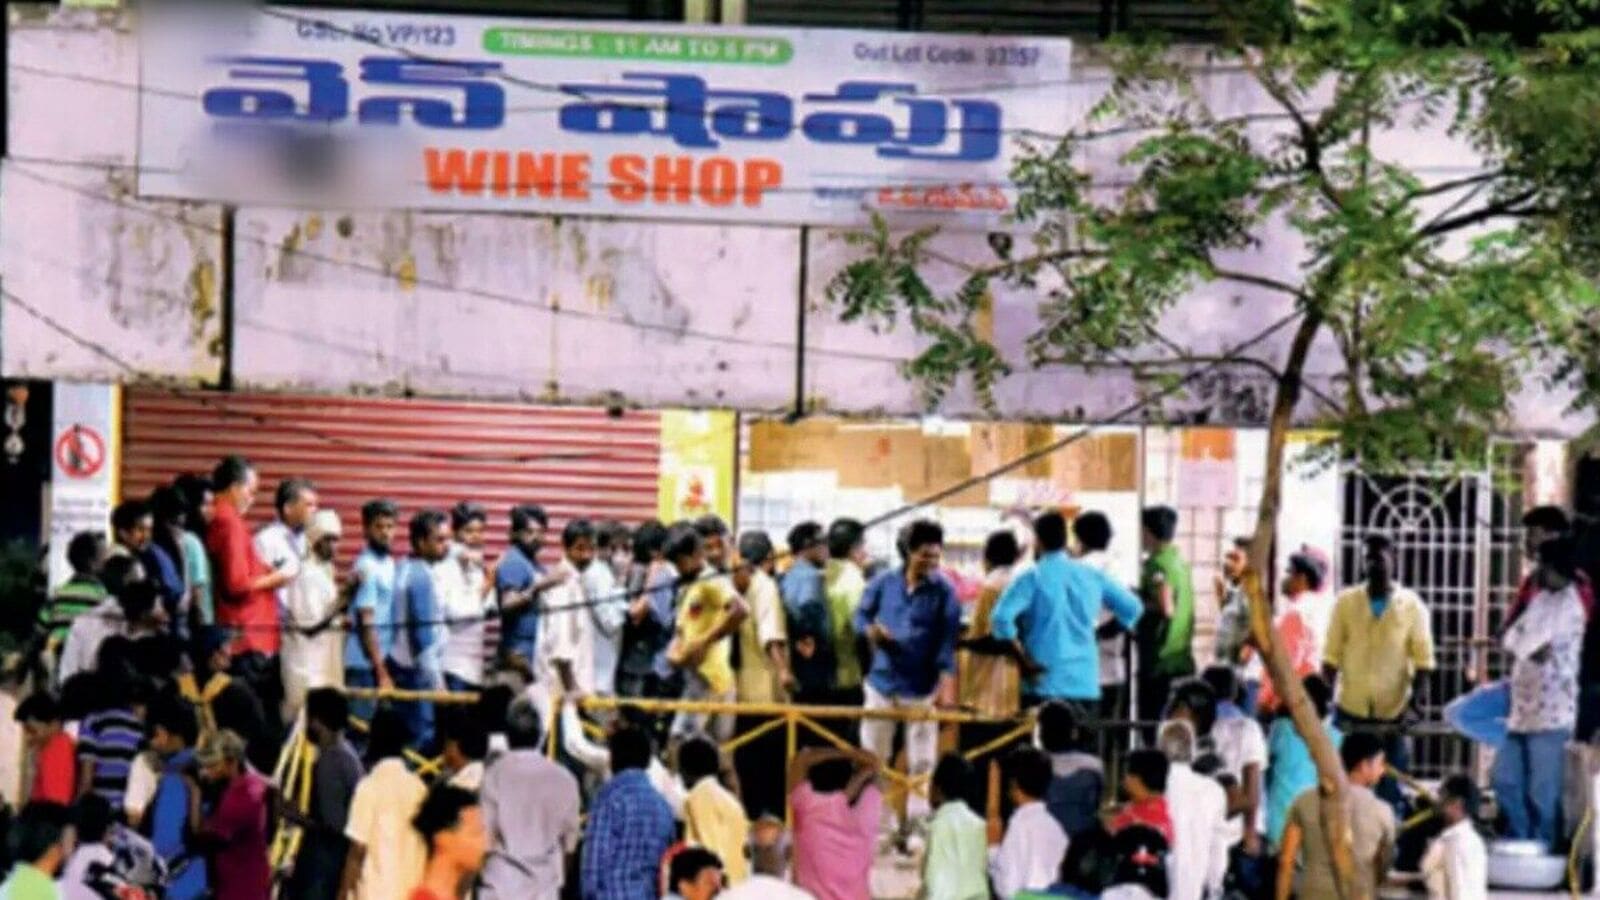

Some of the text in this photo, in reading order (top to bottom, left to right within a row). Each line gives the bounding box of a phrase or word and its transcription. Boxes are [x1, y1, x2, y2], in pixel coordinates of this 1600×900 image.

[499, 31, 592, 53] TIMINGS
[643, 38, 682, 56] AM
[687, 40, 719, 57] TO
[743, 42, 780, 61] PM
[424, 148, 783, 208] WINE SHOP
